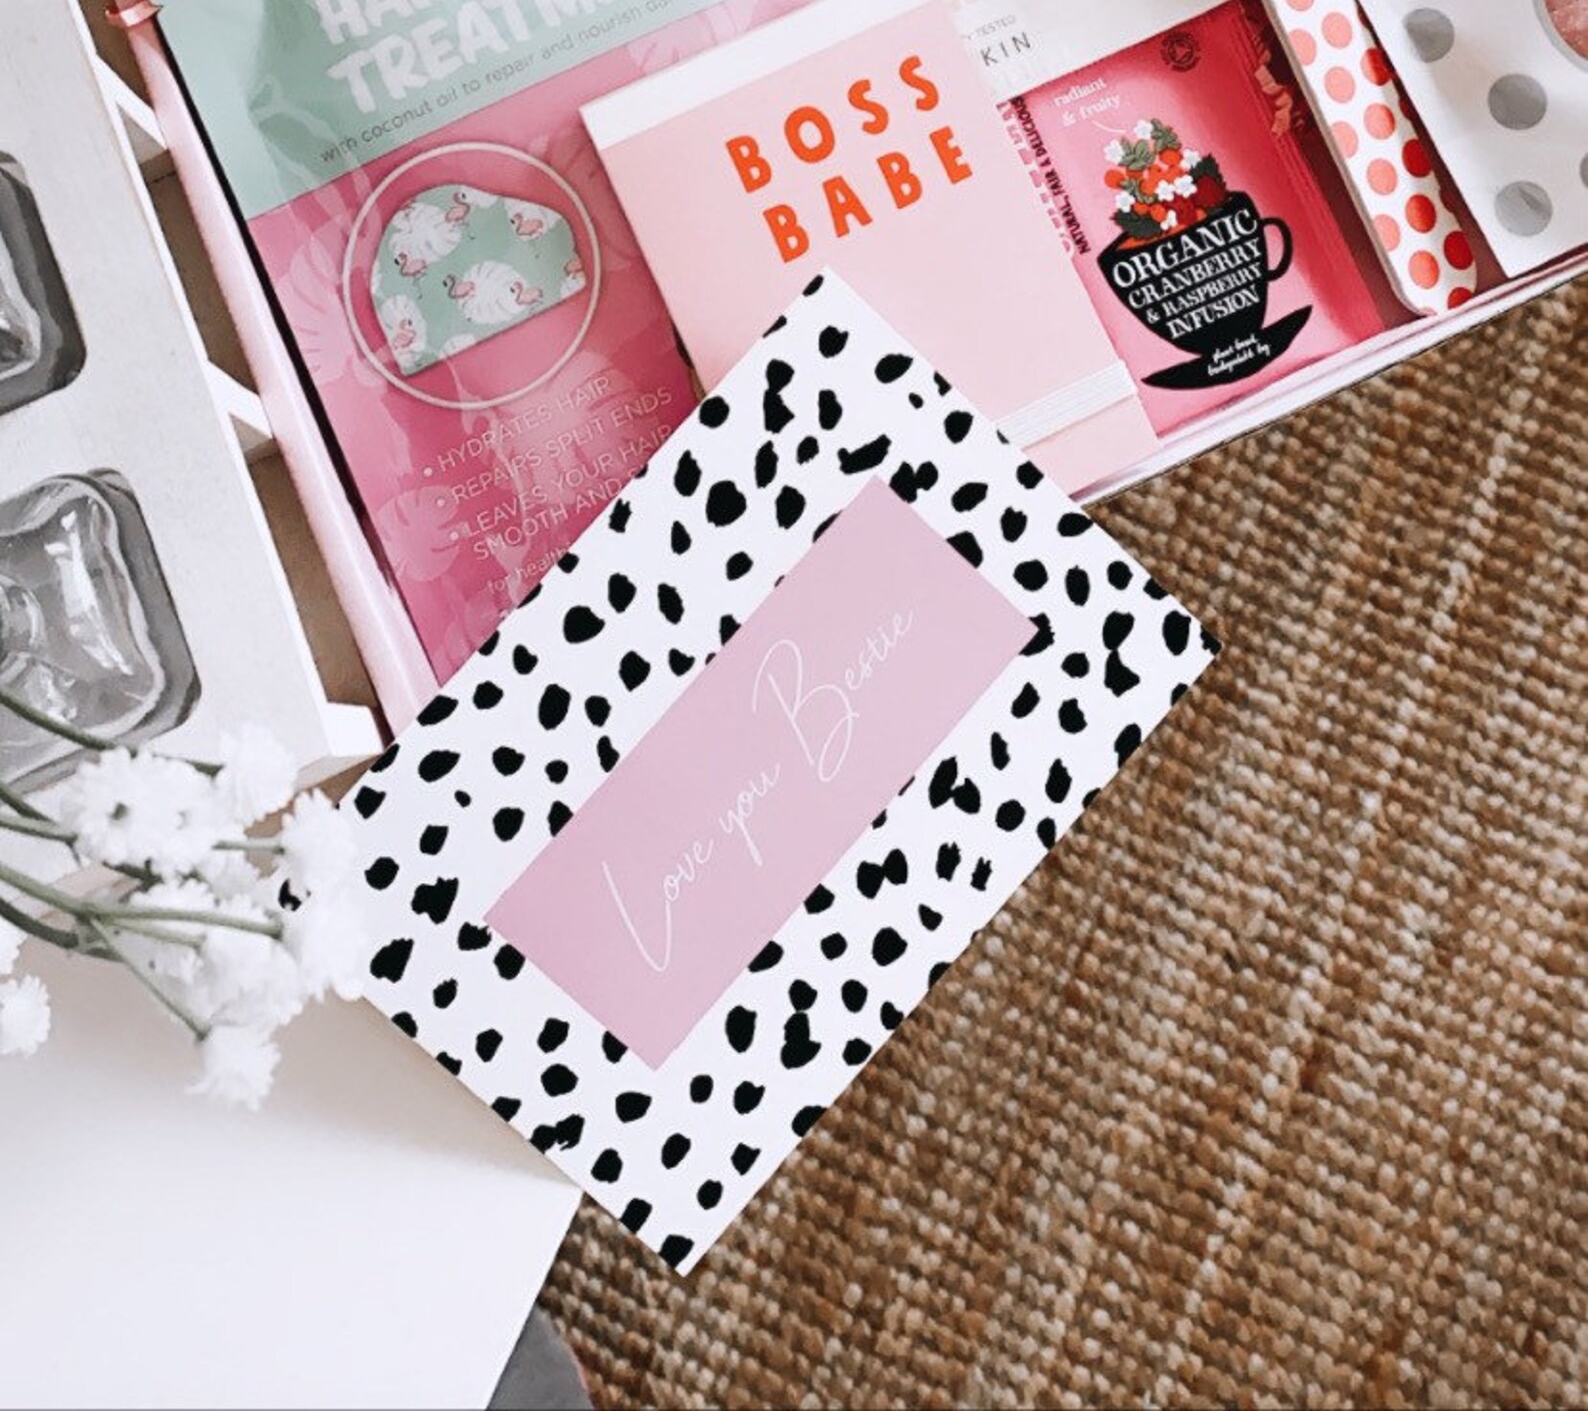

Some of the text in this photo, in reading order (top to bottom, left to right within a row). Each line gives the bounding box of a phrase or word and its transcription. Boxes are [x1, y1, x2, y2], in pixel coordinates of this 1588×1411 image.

[320, 133, 359, 166] with
[360, 98, 434, 145] coconut
[436, 88, 460, 115] oil
[461, 75, 484, 95] to
[483, 51, 537, 87] repair
[539, 32, 576, 63] and
[577, 3, 645, 46] nourish
[725, 54, 940, 194] BOSS
[1053, 77, 1108, 107] radiant
[1080, 93, 1122, 121] fruity
[762, 125, 973, 263] BABE
[1112, 209, 1258, 288] ORGANIC
[1128, 237, 1262, 309] CRANBERRY
[1146, 261, 1262, 324] & RASPBERRY
[1166, 284, 1260, 339] INFUSION
[436, 375, 611, 472] HYDRATES HAIR
[450, 388, 673, 505] REPAIRS SPLIT ENDS
[464, 486, 549, 537] LEAVES
[554, 452, 620, 492] YOUR
[618, 424, 675, 464] HAIR
[472, 477, 623, 562] SMOOTH AND
[512, 540, 571, 580] health
[601, 609, 915, 973] Love you Bestie
